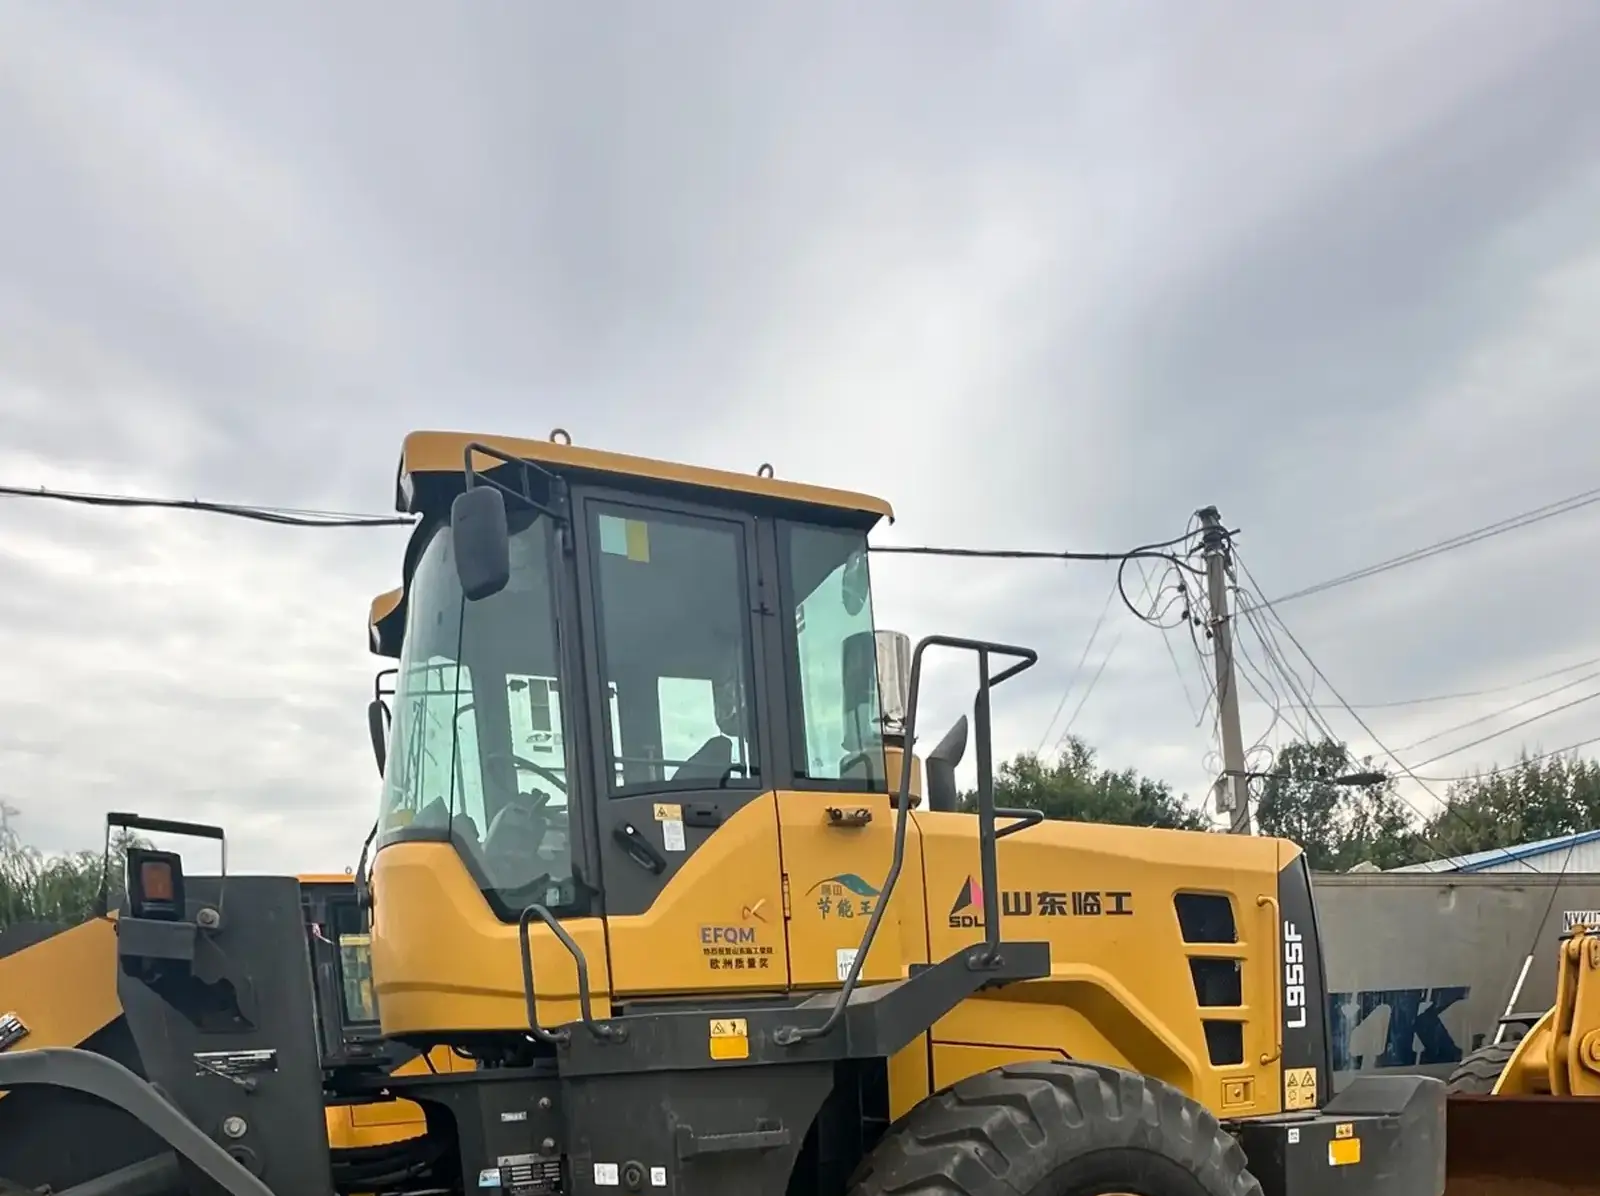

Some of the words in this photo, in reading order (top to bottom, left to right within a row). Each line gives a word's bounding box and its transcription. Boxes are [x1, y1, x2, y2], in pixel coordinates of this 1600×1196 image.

[817, 897, 874, 920] 节能王
[1002, 891, 1134, 916] 山东临工
[949, 915, 986, 928] SDL
[1564, 911, 1600, 932] NYKU
[701, 926, 755, 944] EFQM
[709, 957, 769, 969] 欧洲质量奖
[1284, 920, 1306, 1028] L955F
